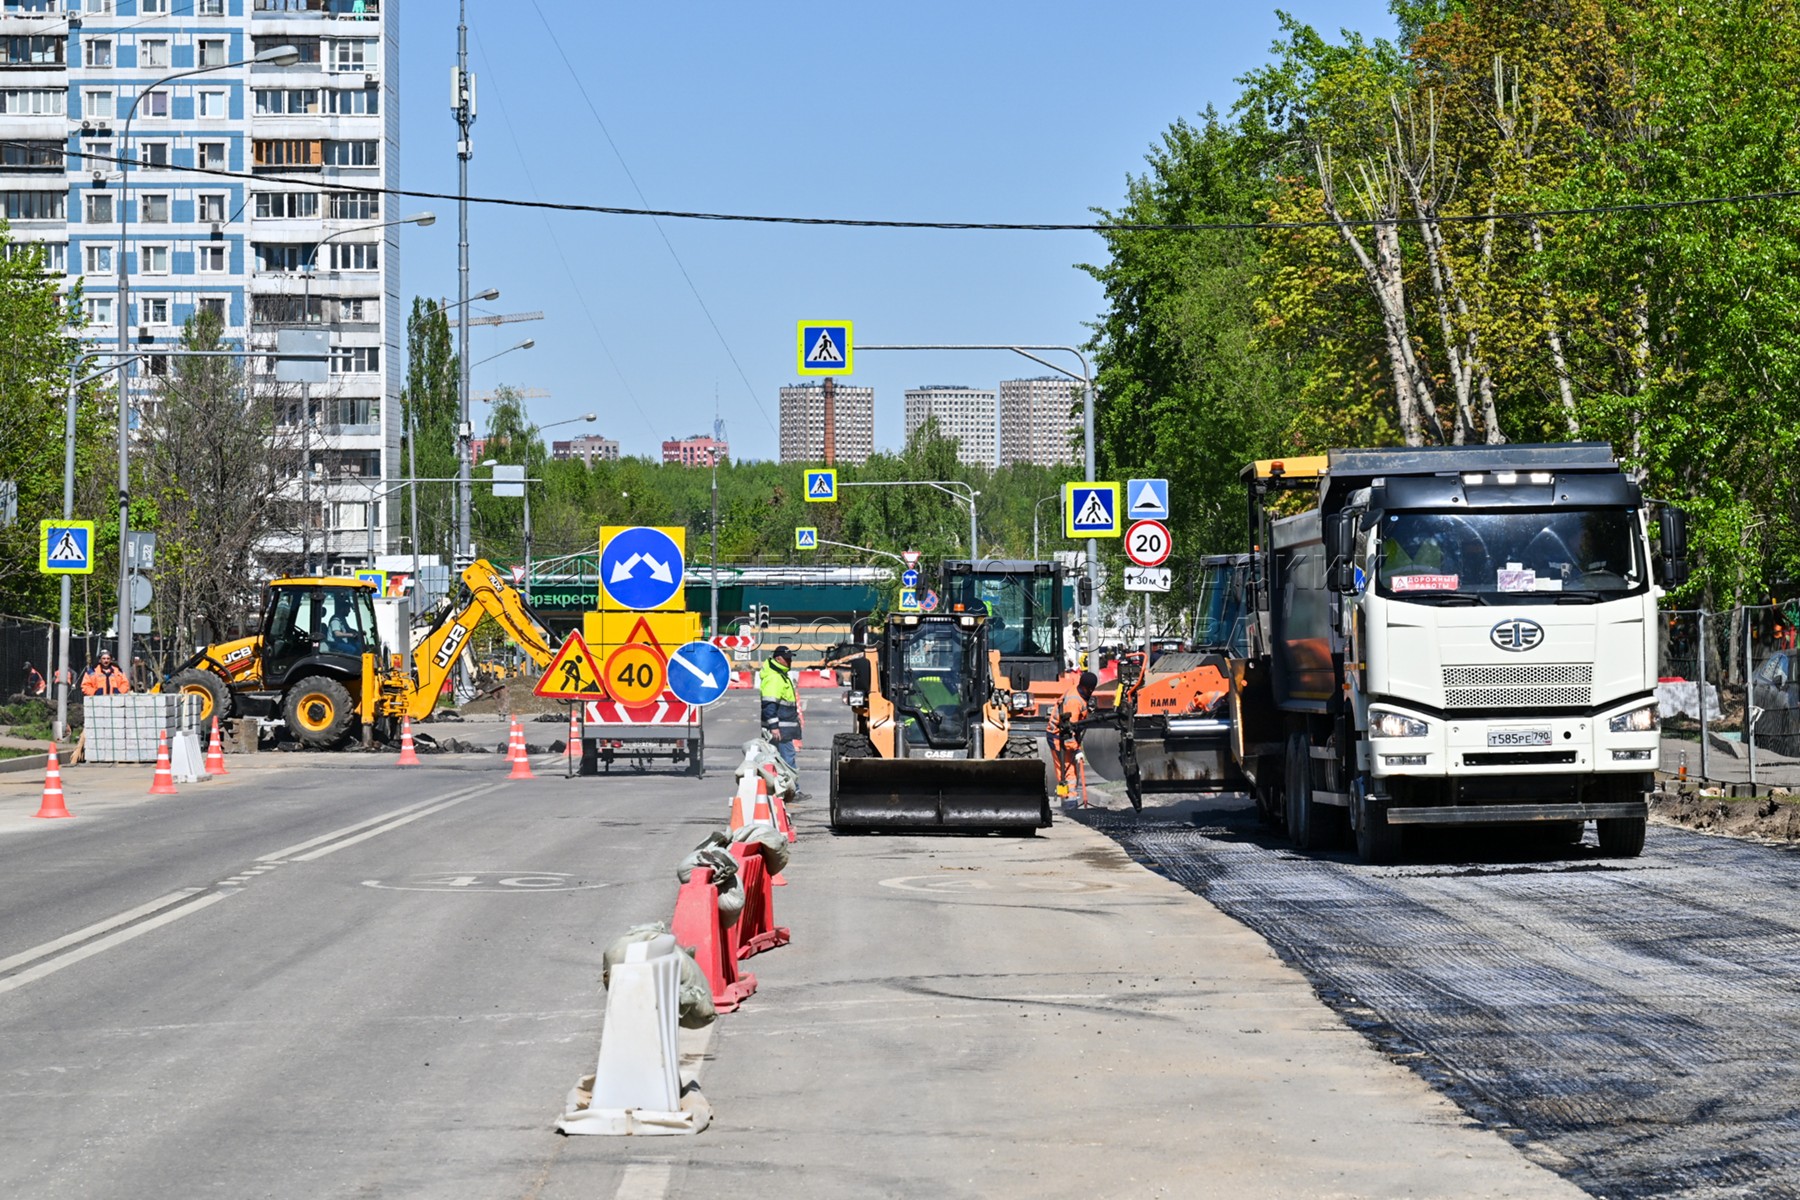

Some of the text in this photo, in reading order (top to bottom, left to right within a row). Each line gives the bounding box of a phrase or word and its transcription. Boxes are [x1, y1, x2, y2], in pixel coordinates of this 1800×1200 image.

[1136, 534, 1161, 553] 20
[529, 594, 599, 608] ерекрест
[436, 623, 468, 668] JCB
[223, 646, 252, 664] JCB
[617, 663, 654, 688] 40
[1150, 698, 1177, 707] HAMM
[924, 750, 954, 759] CASE
